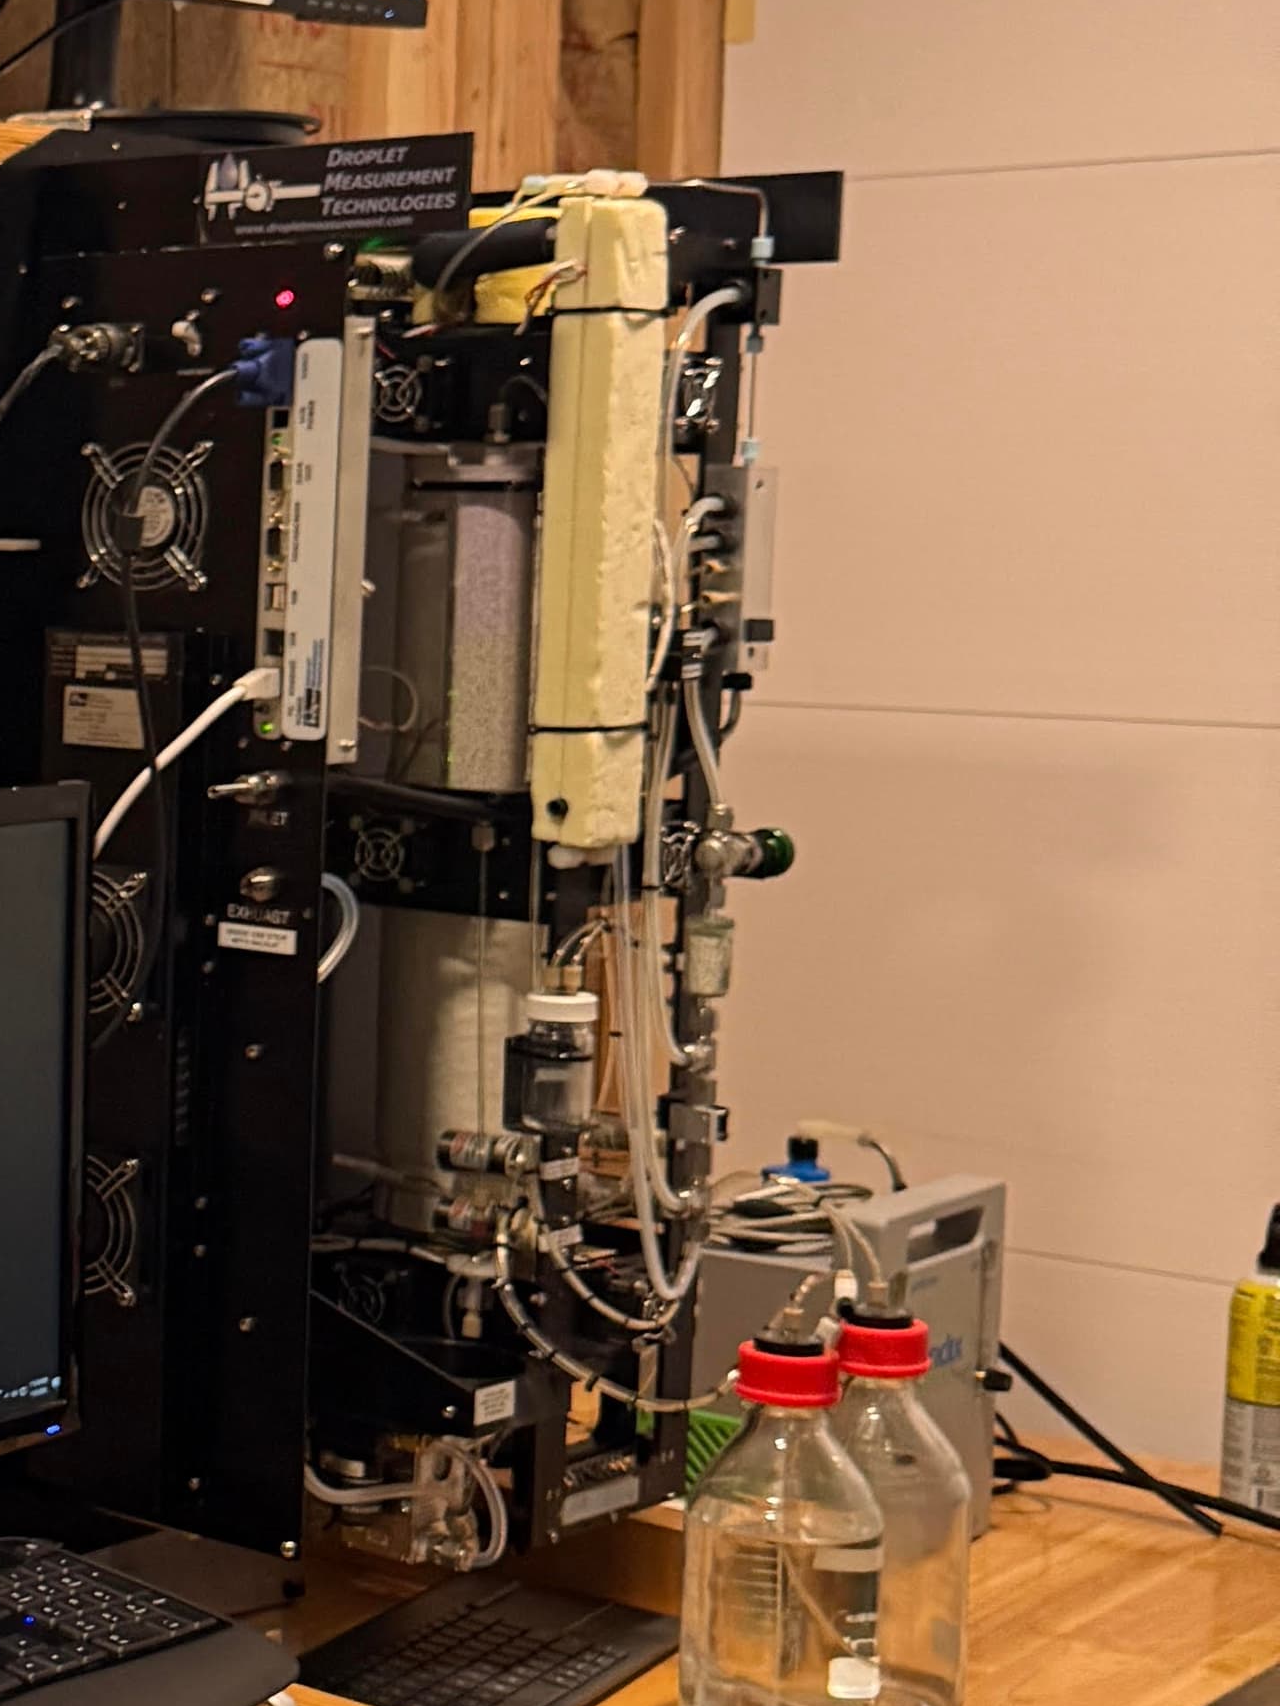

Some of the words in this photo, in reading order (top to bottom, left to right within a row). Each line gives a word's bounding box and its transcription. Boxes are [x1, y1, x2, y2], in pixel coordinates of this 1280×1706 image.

[326, 145, 408, 168] DROPLET
[324, 167, 457, 192] MEASUREMENT
[321, 192, 457, 217] TECHNOLOGIES
